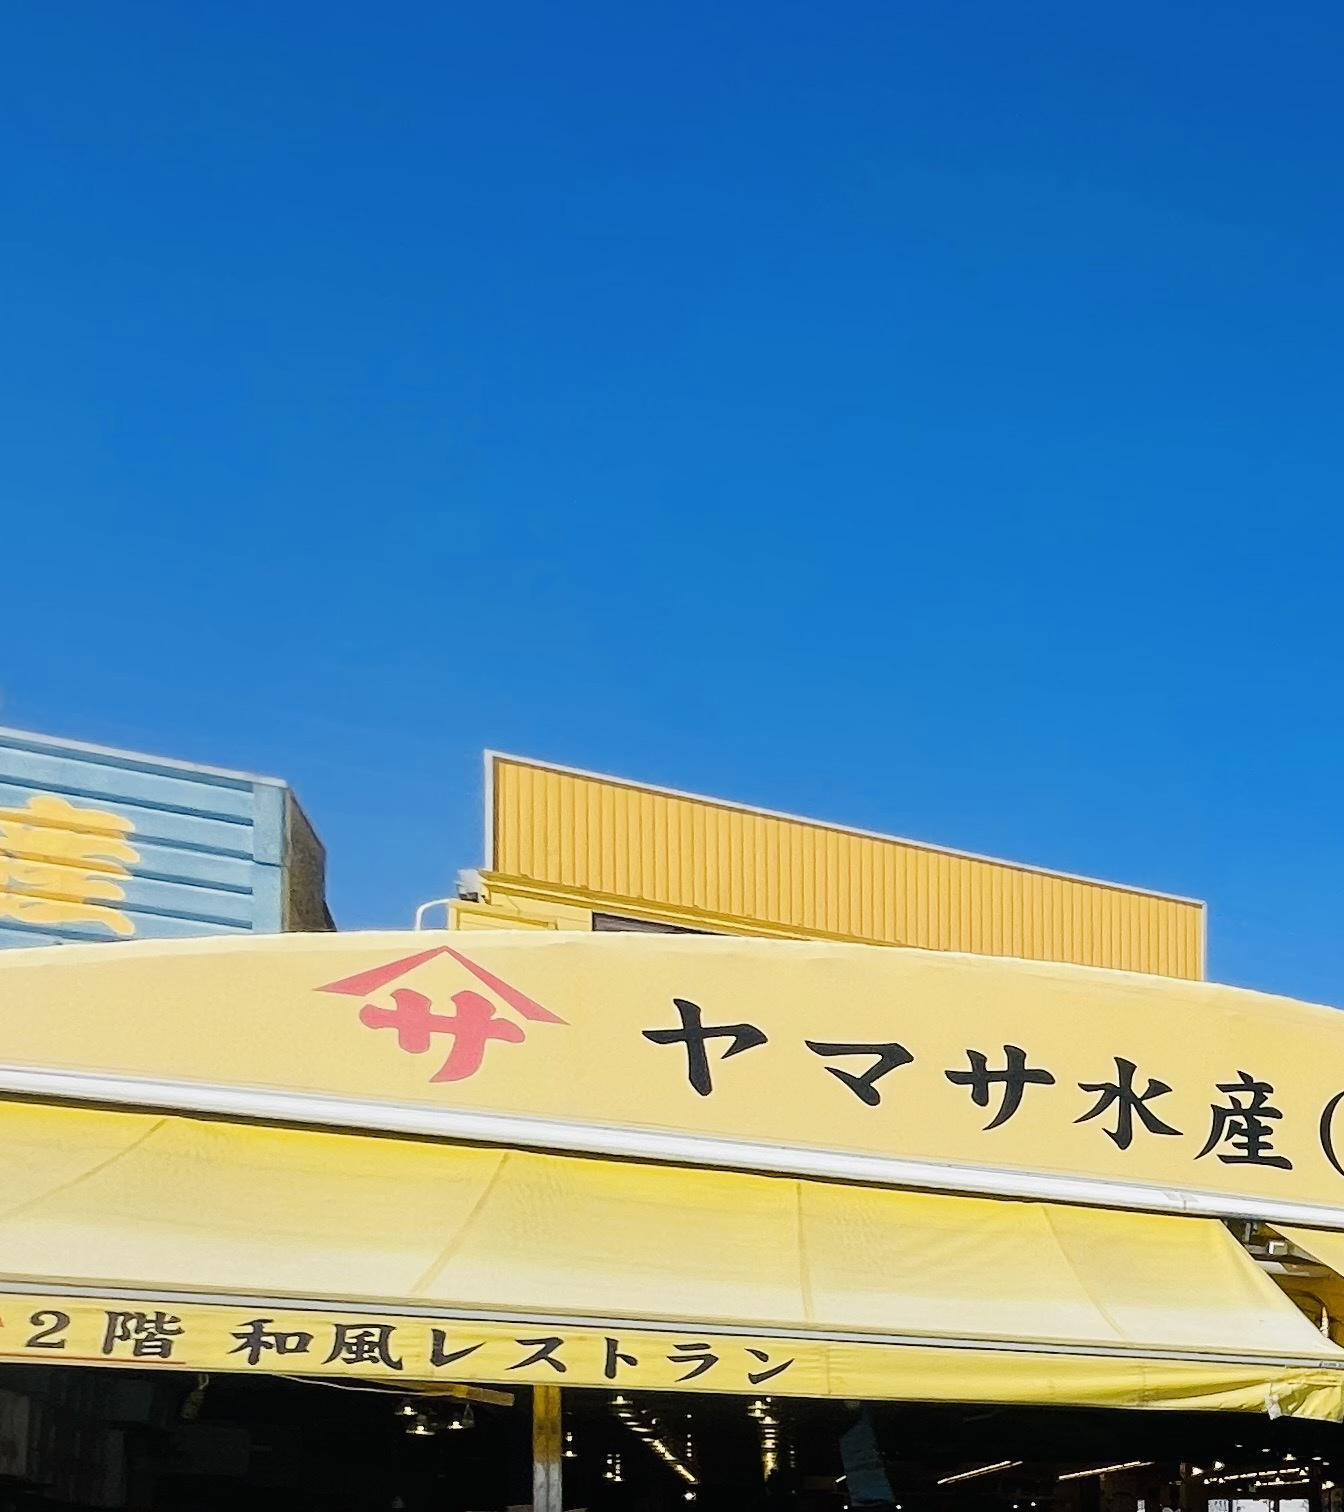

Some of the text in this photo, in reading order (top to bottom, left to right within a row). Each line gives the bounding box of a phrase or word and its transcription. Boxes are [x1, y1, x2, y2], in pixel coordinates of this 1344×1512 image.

[24, 1309, 796, 1387] 2階 和風レストラン
